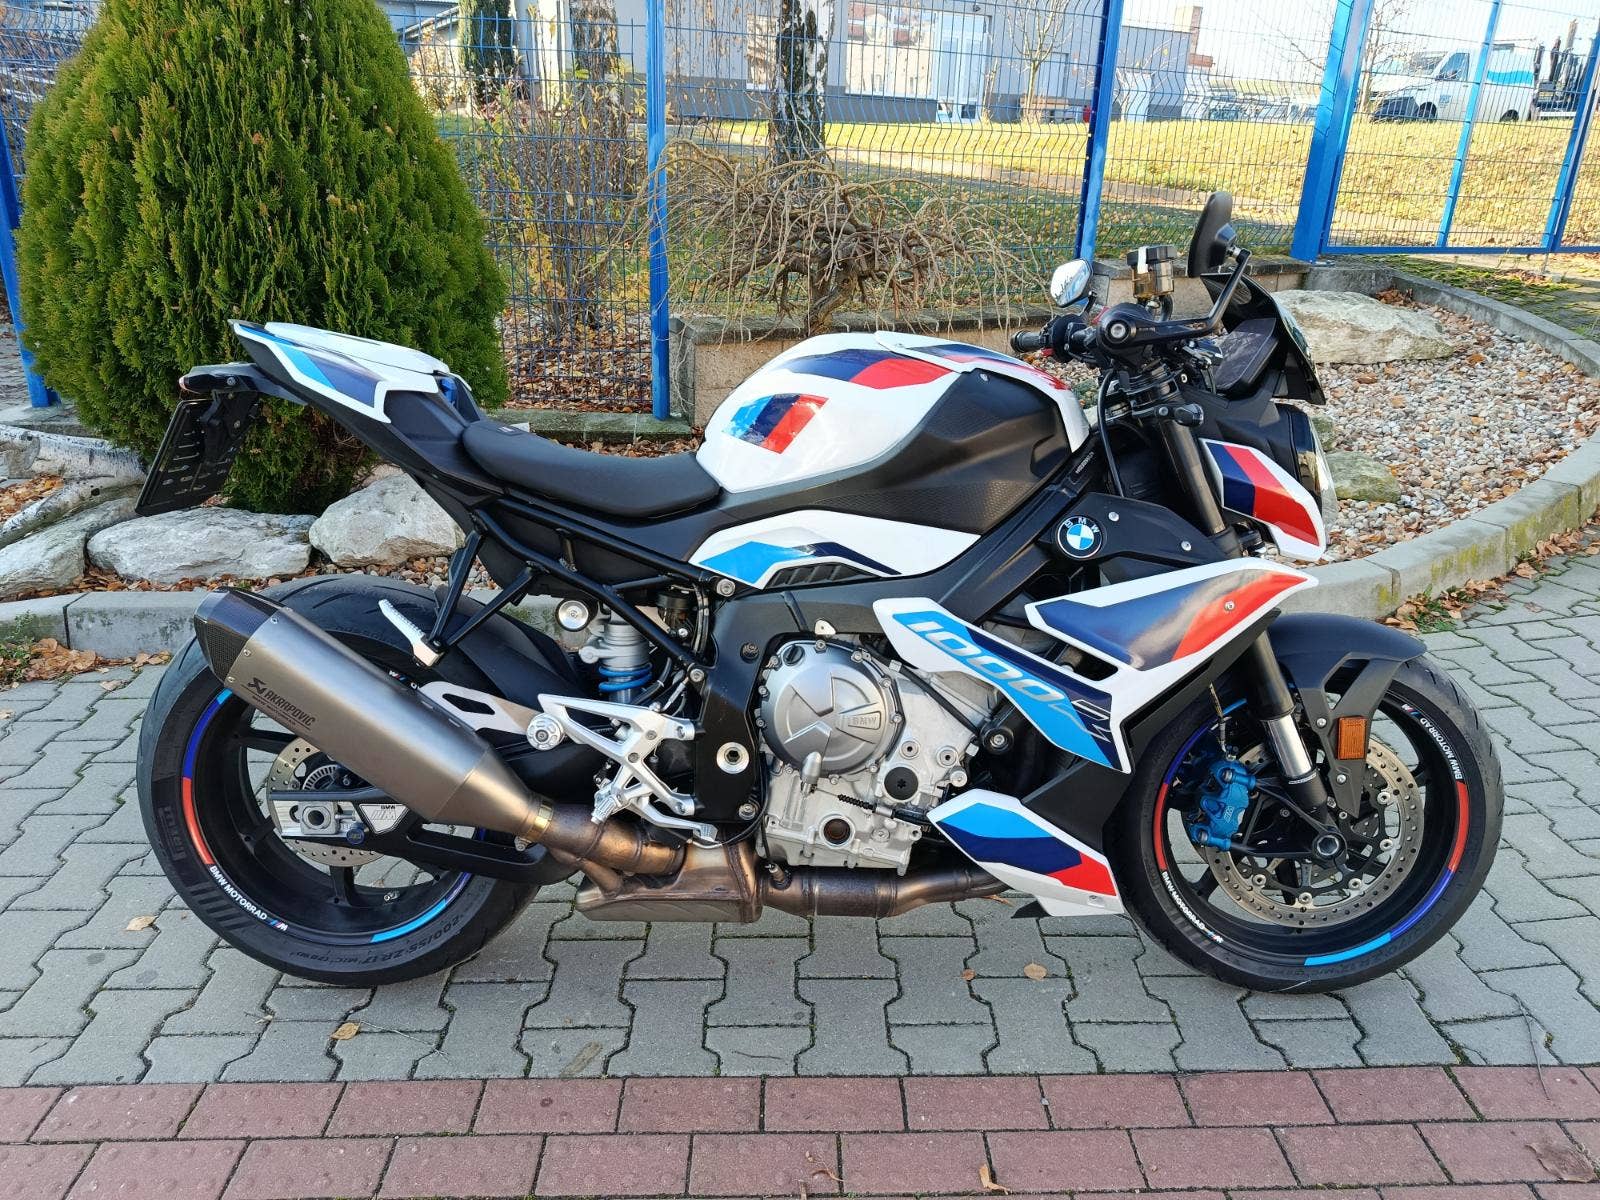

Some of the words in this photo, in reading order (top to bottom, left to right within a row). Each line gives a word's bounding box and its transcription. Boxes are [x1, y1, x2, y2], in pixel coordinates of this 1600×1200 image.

[1064, 517, 1100, 533] BMW
[907, 621, 1065, 702] 1000
[1420, 717, 1455, 759] MOTORRAD
[1449, 759, 1463, 779] BMW
[209, 865, 228, 887] BMW
[223, 884, 268, 920] MOTORRAD
